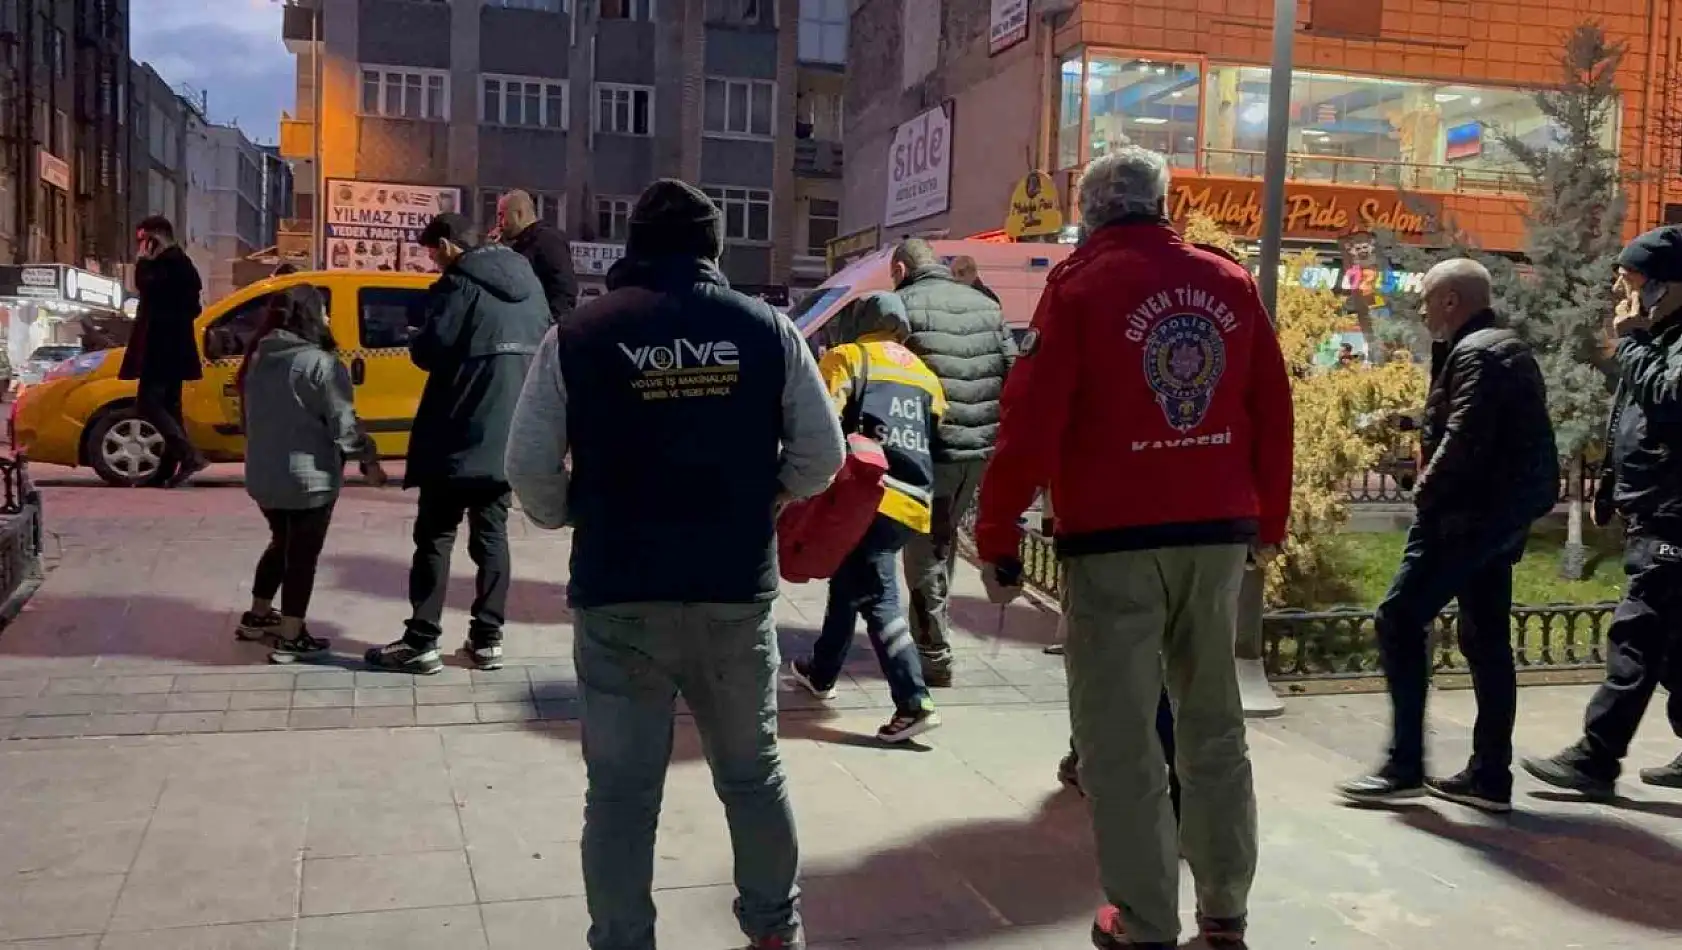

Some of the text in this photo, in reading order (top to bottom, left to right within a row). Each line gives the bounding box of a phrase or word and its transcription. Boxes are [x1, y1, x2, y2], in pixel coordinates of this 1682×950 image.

[894, 112, 943, 182] side
[333, 207, 393, 225] YILMAZ
[1175, 186, 1264, 236] Malaty
[1287, 194, 1349, 232] Pide
[1125, 282, 1241, 342] GÜVEN TİMLERİ
[630, 377, 665, 389] VOLVE
[889, 396, 922, 421] ACİ
[1659, 544, 1681, 556] PO
